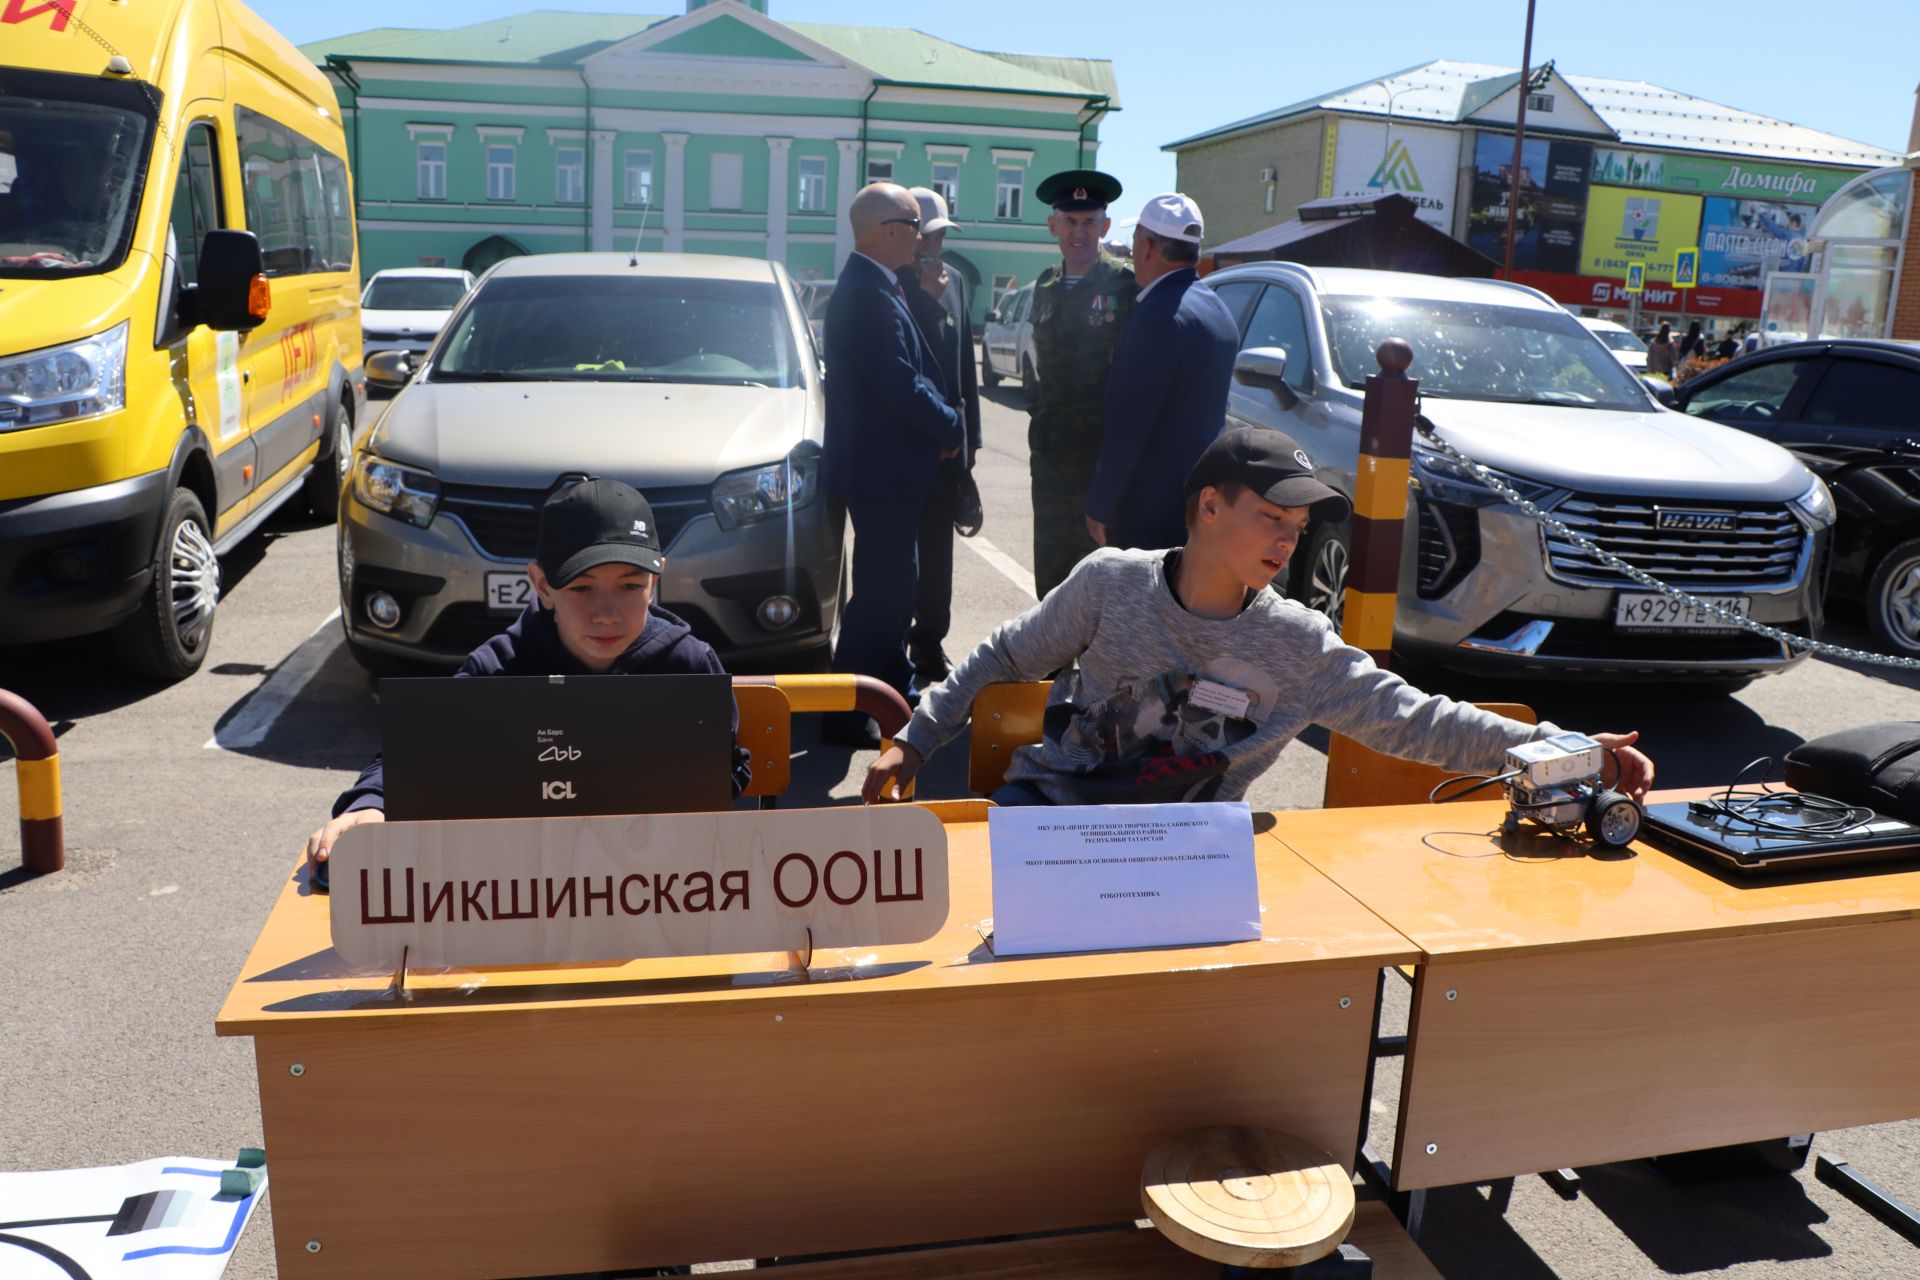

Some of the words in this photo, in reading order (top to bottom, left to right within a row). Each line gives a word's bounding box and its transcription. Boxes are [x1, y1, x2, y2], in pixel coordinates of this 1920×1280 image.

[1721, 166, 1817, 198] Домифа
[281, 322, 317, 404] ДЕТИ
[1662, 514, 1733, 530] HAVAL
[547, 729, 564, 737] Барс
[542, 780, 577, 800] ICL
[1090, 823, 1123, 831] ДЕТСКОГО
[1167, 820, 1209, 829] САБИНСКОГО
[1142, 828, 1168, 836] РАЙОНА
[1084, 836, 1126, 844] РЕСПУБЛИКИ
[1128, 835, 1164, 843] ТАТАРСТАН
[1025, 859, 1043, 867] МБОУ
[1044, 858, 1092, 866] ШИКШИНСКАЯ
[1092, 857, 1127, 865] ОСНОВНАЯ
[1128, 854, 1206, 864] ОБЩЕОБРАЗОВАТЕЛЬНАЯ
[1206, 853, 1230, 861] ШКОЛА
[359, 867, 751, 926] Шикшинская
[772, 847, 924, 909] ООШ
[1099, 890, 1161, 900] РОБОТОТЕХНИКА
